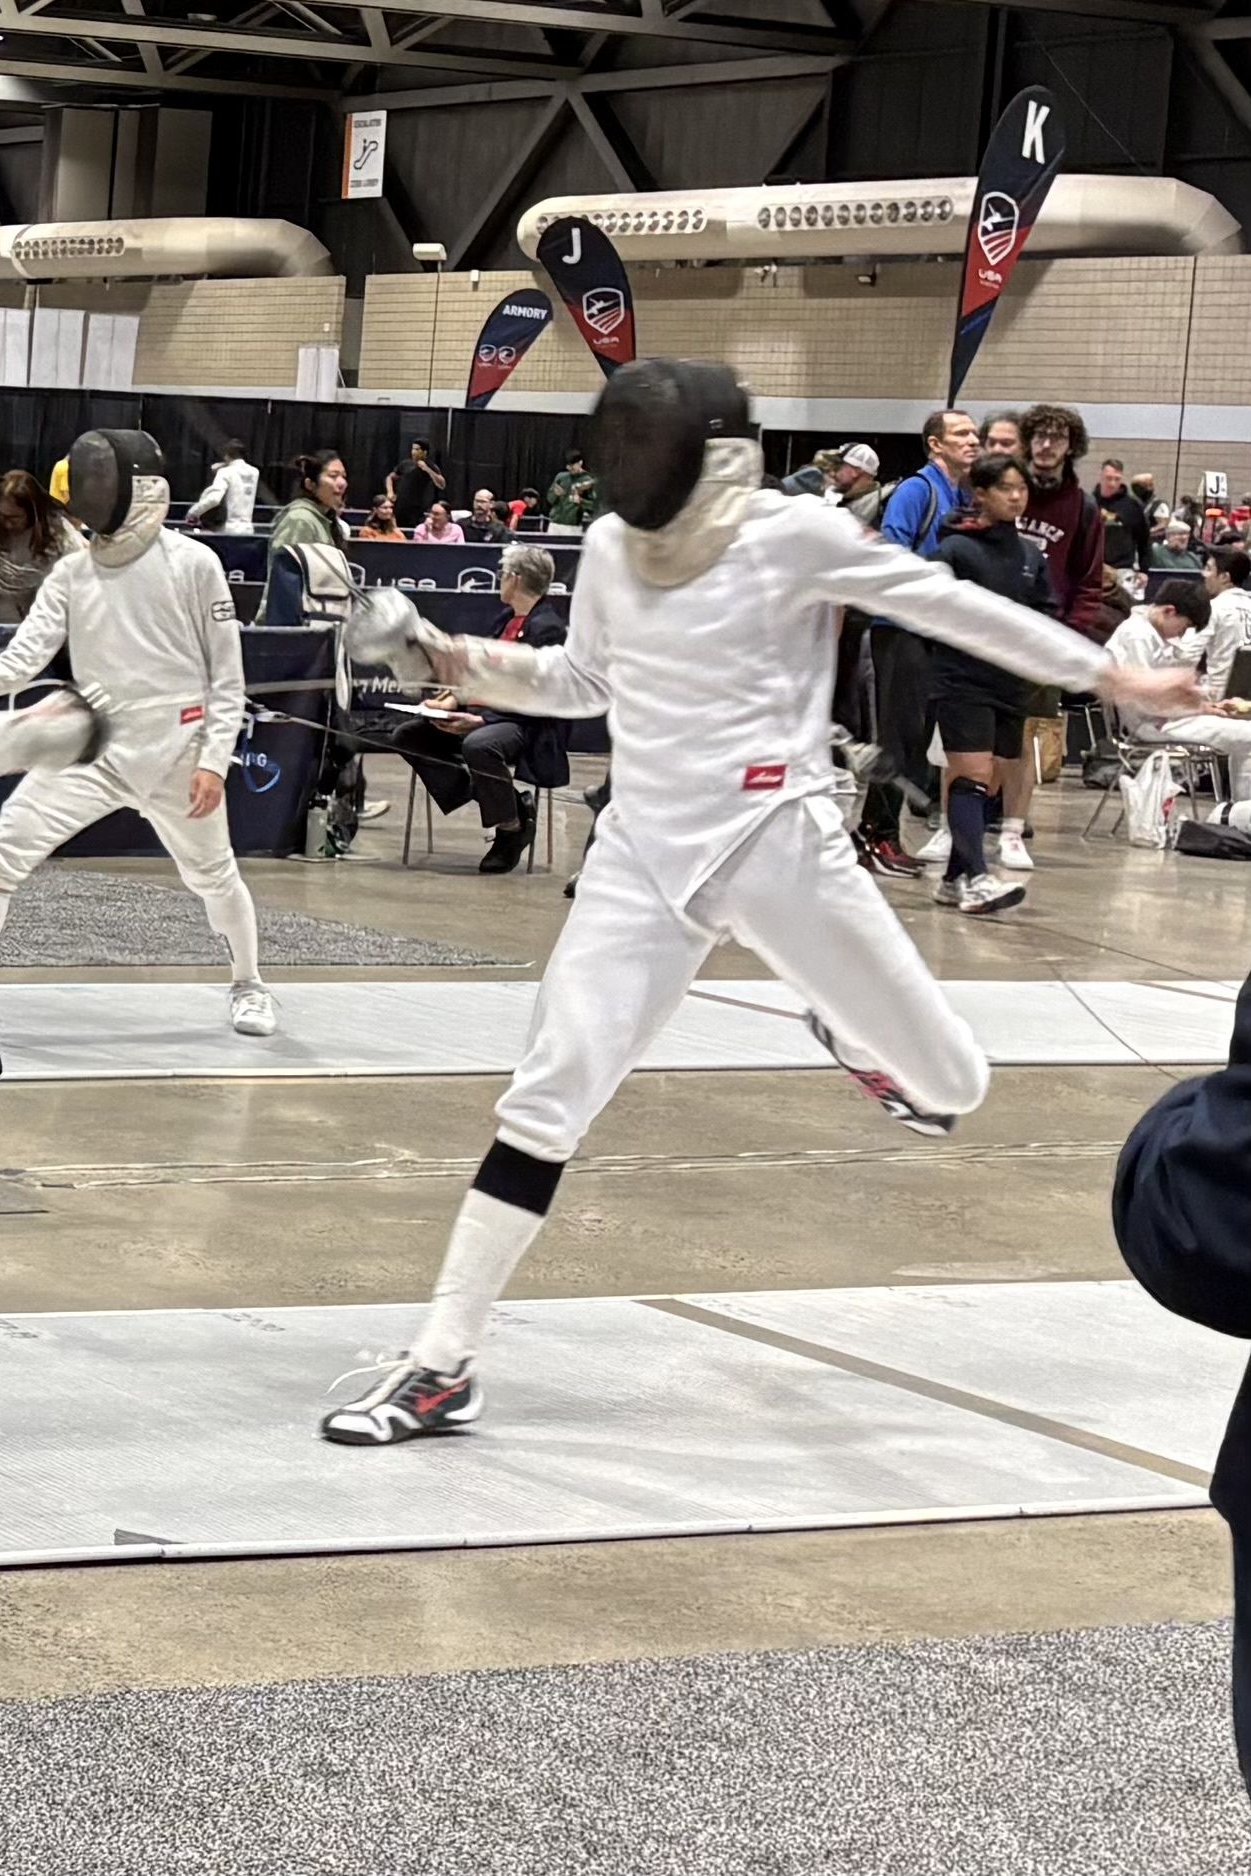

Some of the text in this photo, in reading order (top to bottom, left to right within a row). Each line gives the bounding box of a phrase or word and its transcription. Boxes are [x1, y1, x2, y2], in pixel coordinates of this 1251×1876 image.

[1021, 100, 1050, 165] K
[562, 228, 581, 264] J
[502, 304, 549, 321] ARMORY
[1209, 476, 1220, 494] J
